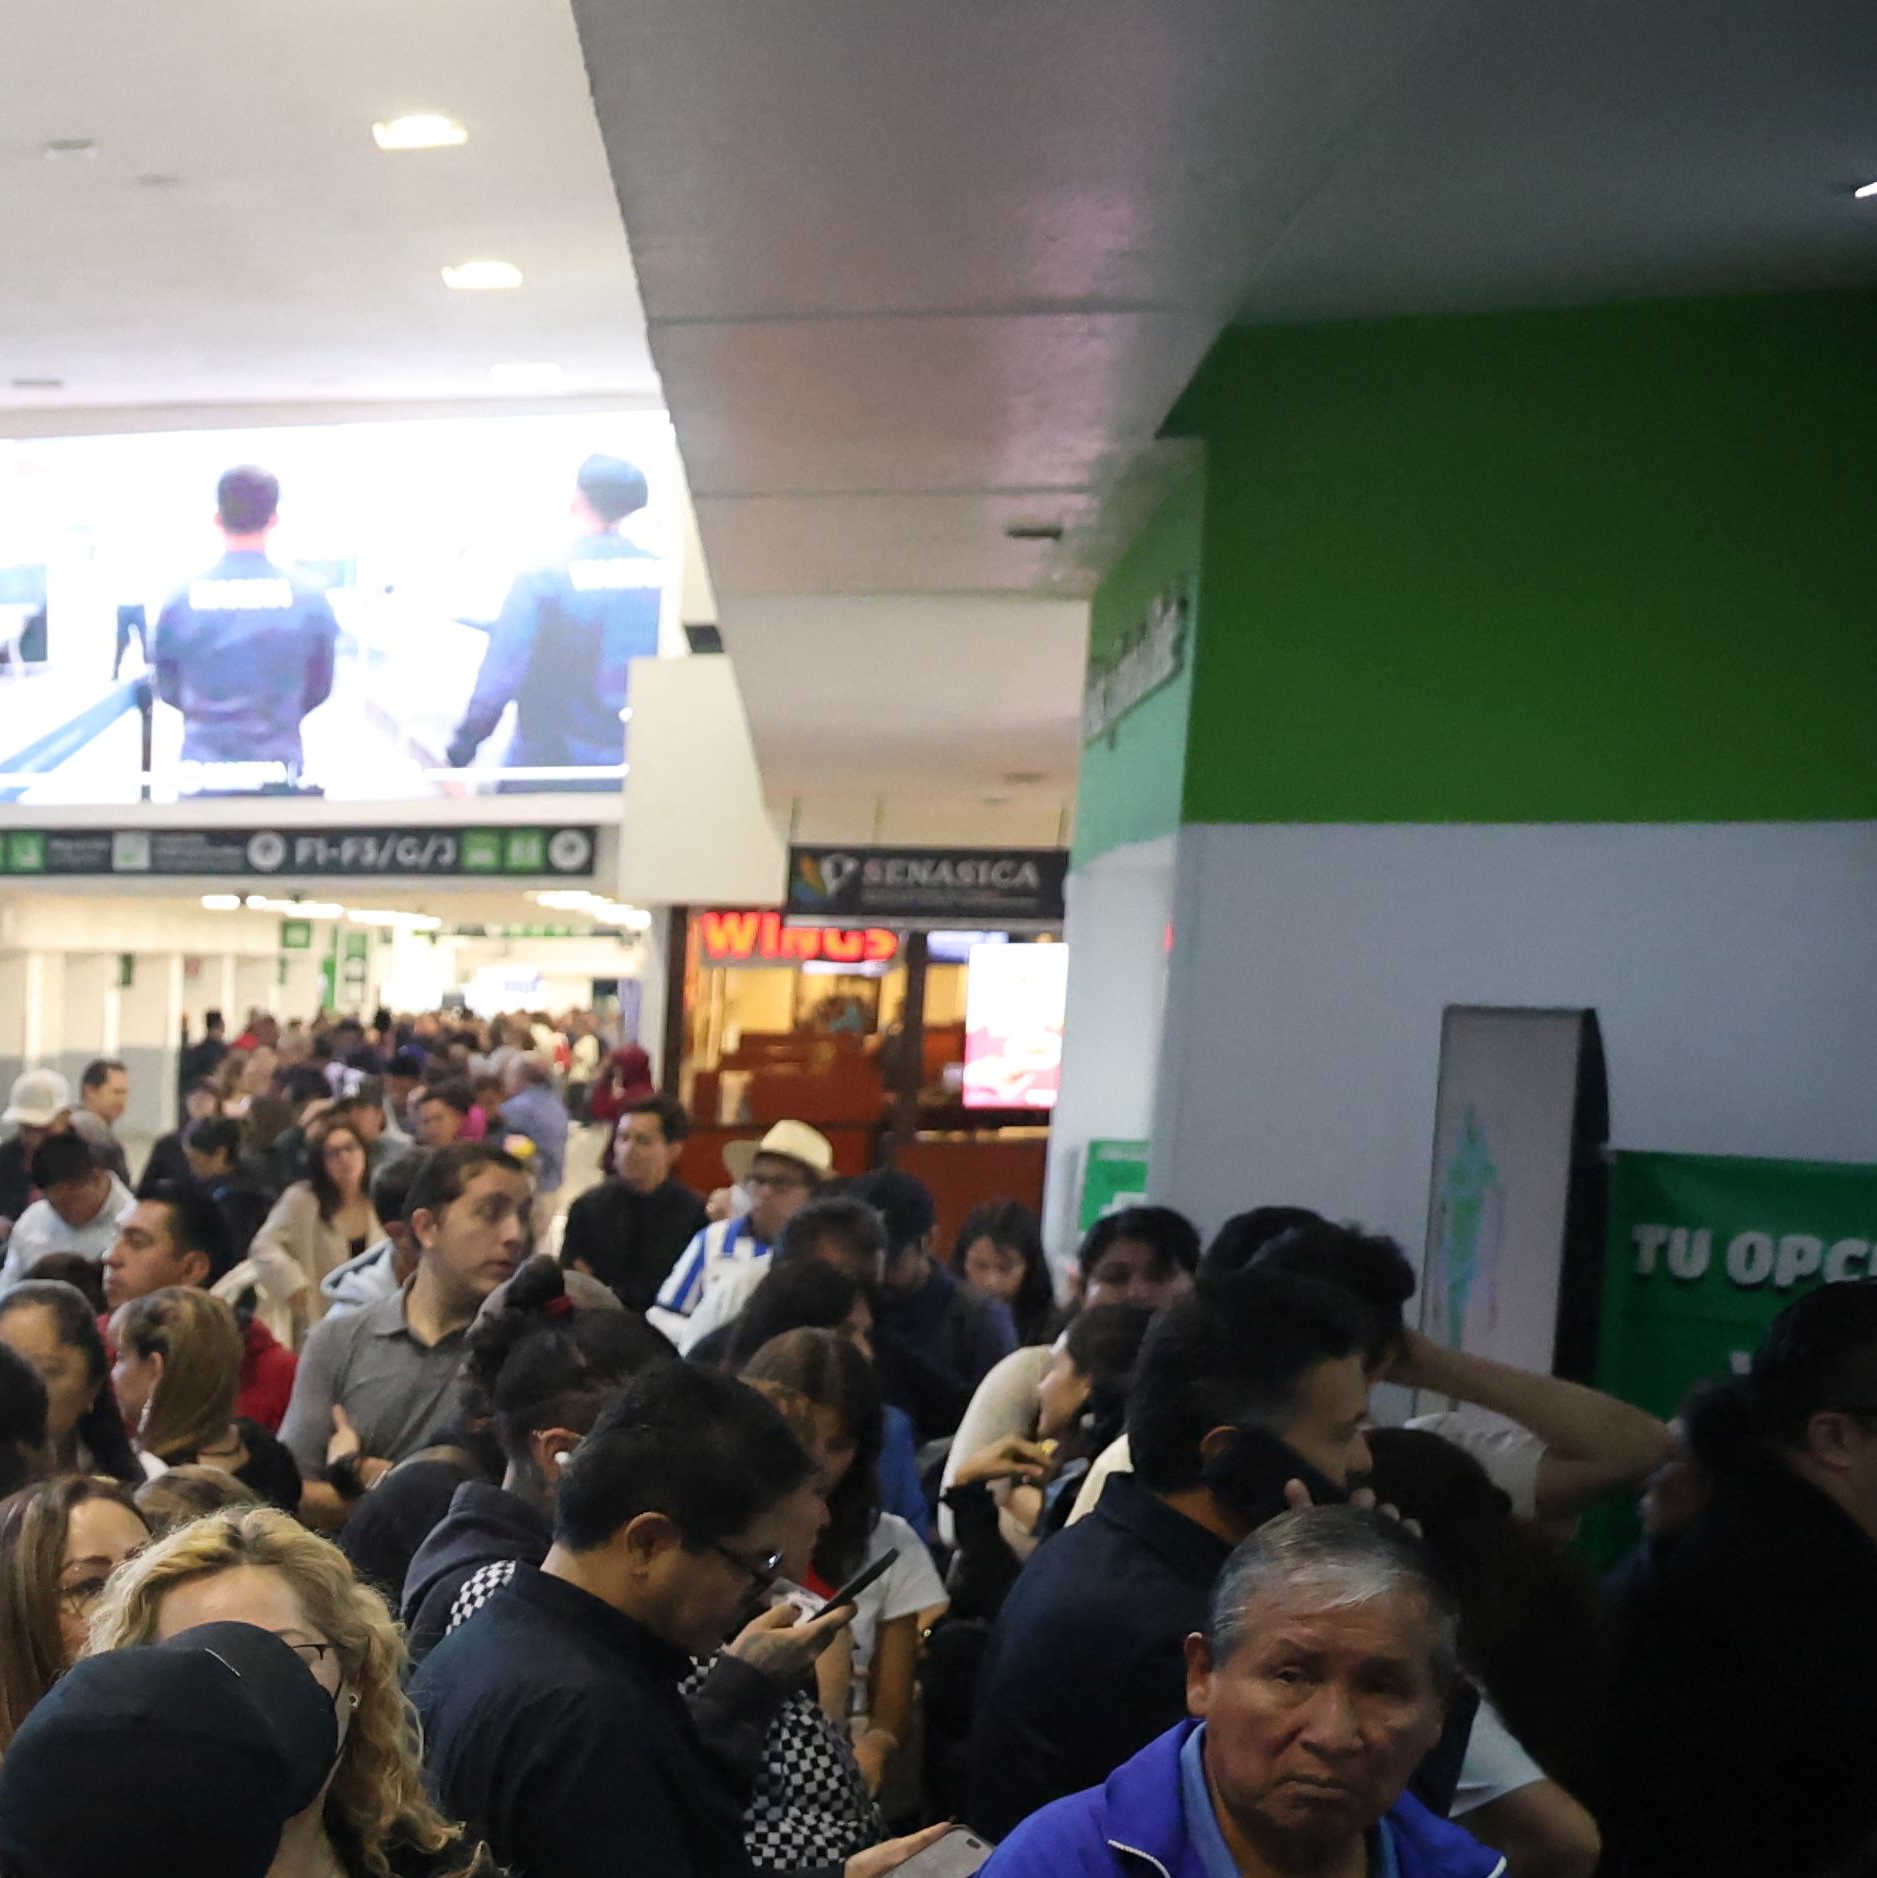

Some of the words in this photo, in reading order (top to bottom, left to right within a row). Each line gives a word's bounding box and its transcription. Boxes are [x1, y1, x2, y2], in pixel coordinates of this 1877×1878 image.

[863, 857, 1041, 890] SENASICA
[1630, 1222, 1712, 1280] TU
[1725, 1230, 1877, 1287] OPC
